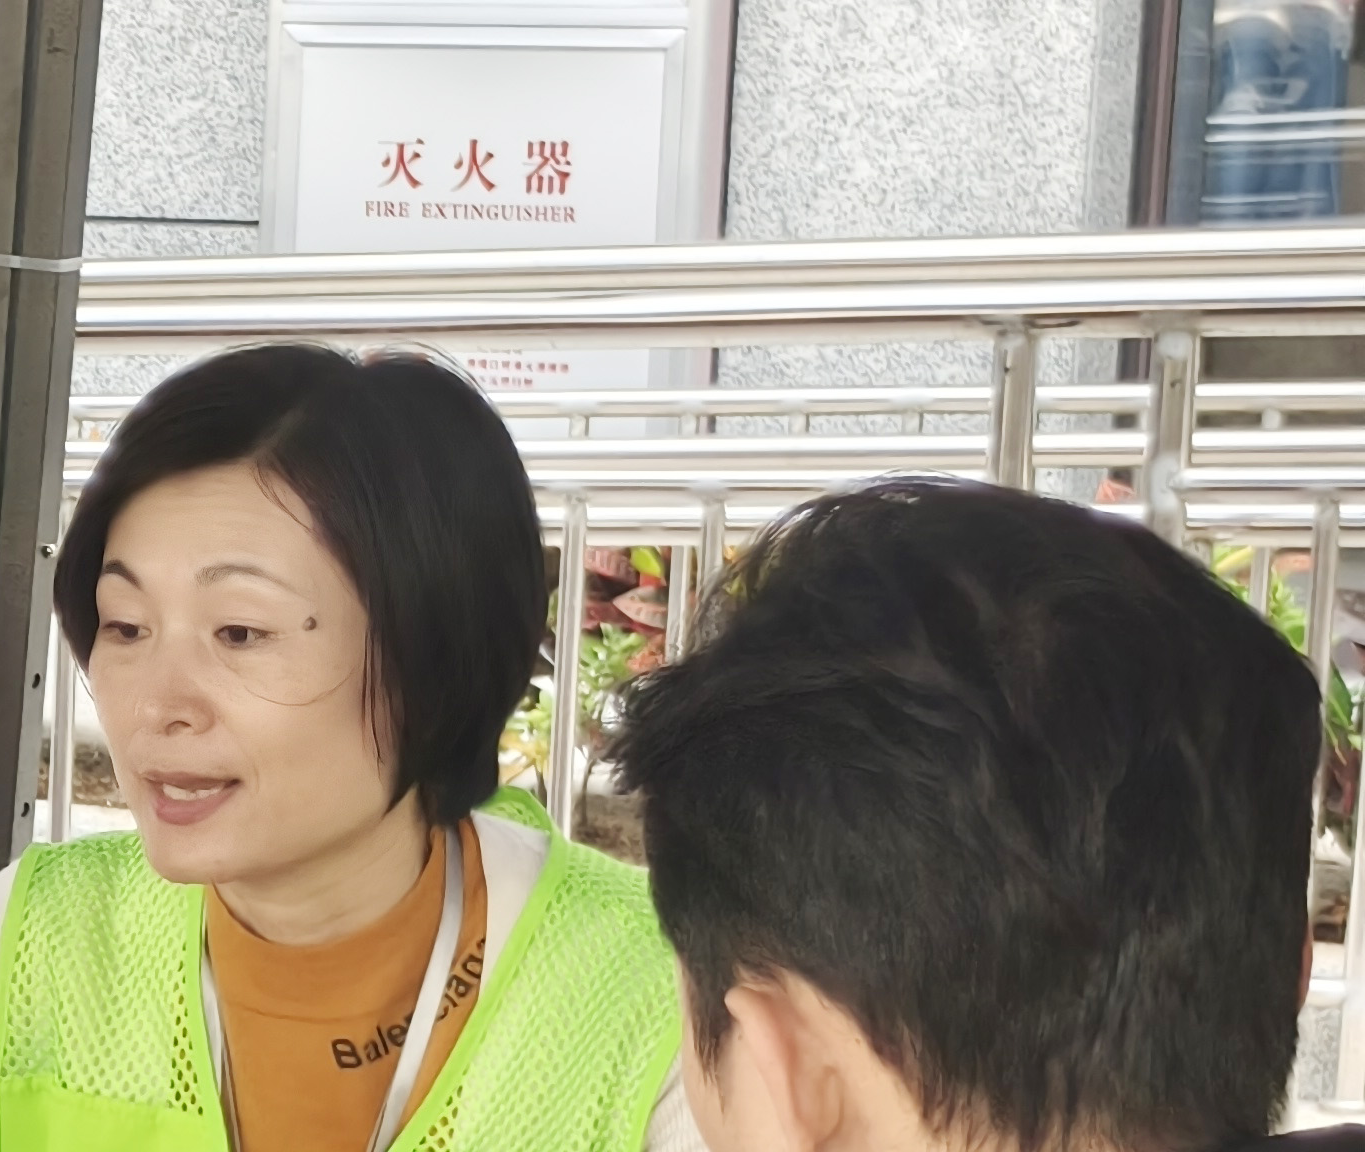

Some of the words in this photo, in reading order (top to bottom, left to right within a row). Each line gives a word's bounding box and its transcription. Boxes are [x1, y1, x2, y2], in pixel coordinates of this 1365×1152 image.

[376, 138, 573, 196] 灭火器
[364, 200, 411, 219] FIRE
[421, 202, 577, 223] EXTINGUISHER
